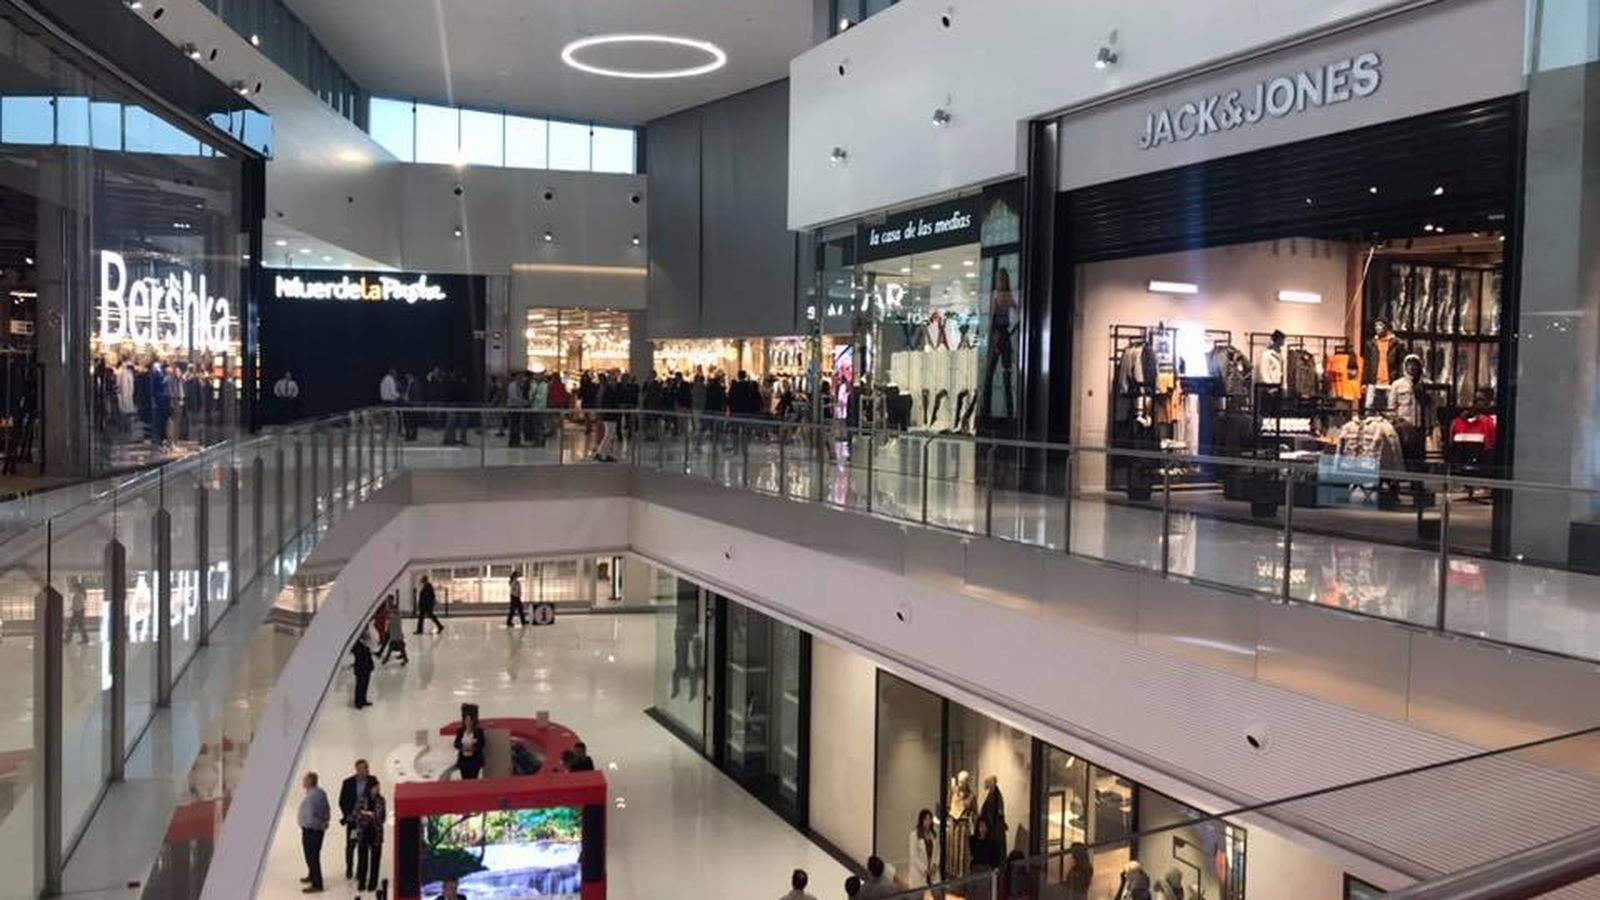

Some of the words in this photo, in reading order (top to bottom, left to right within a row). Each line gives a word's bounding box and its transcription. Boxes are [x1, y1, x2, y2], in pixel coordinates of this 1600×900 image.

[1139, 52, 1381, 149] JACK&JONES
[869, 229, 880, 245] la
[881, 229, 901, 243] casa
[904, 220, 916, 239] de
[917, 219, 933, 237] las
[934, 211, 971, 233] medias
[100, 249, 231, 354] Bershka
